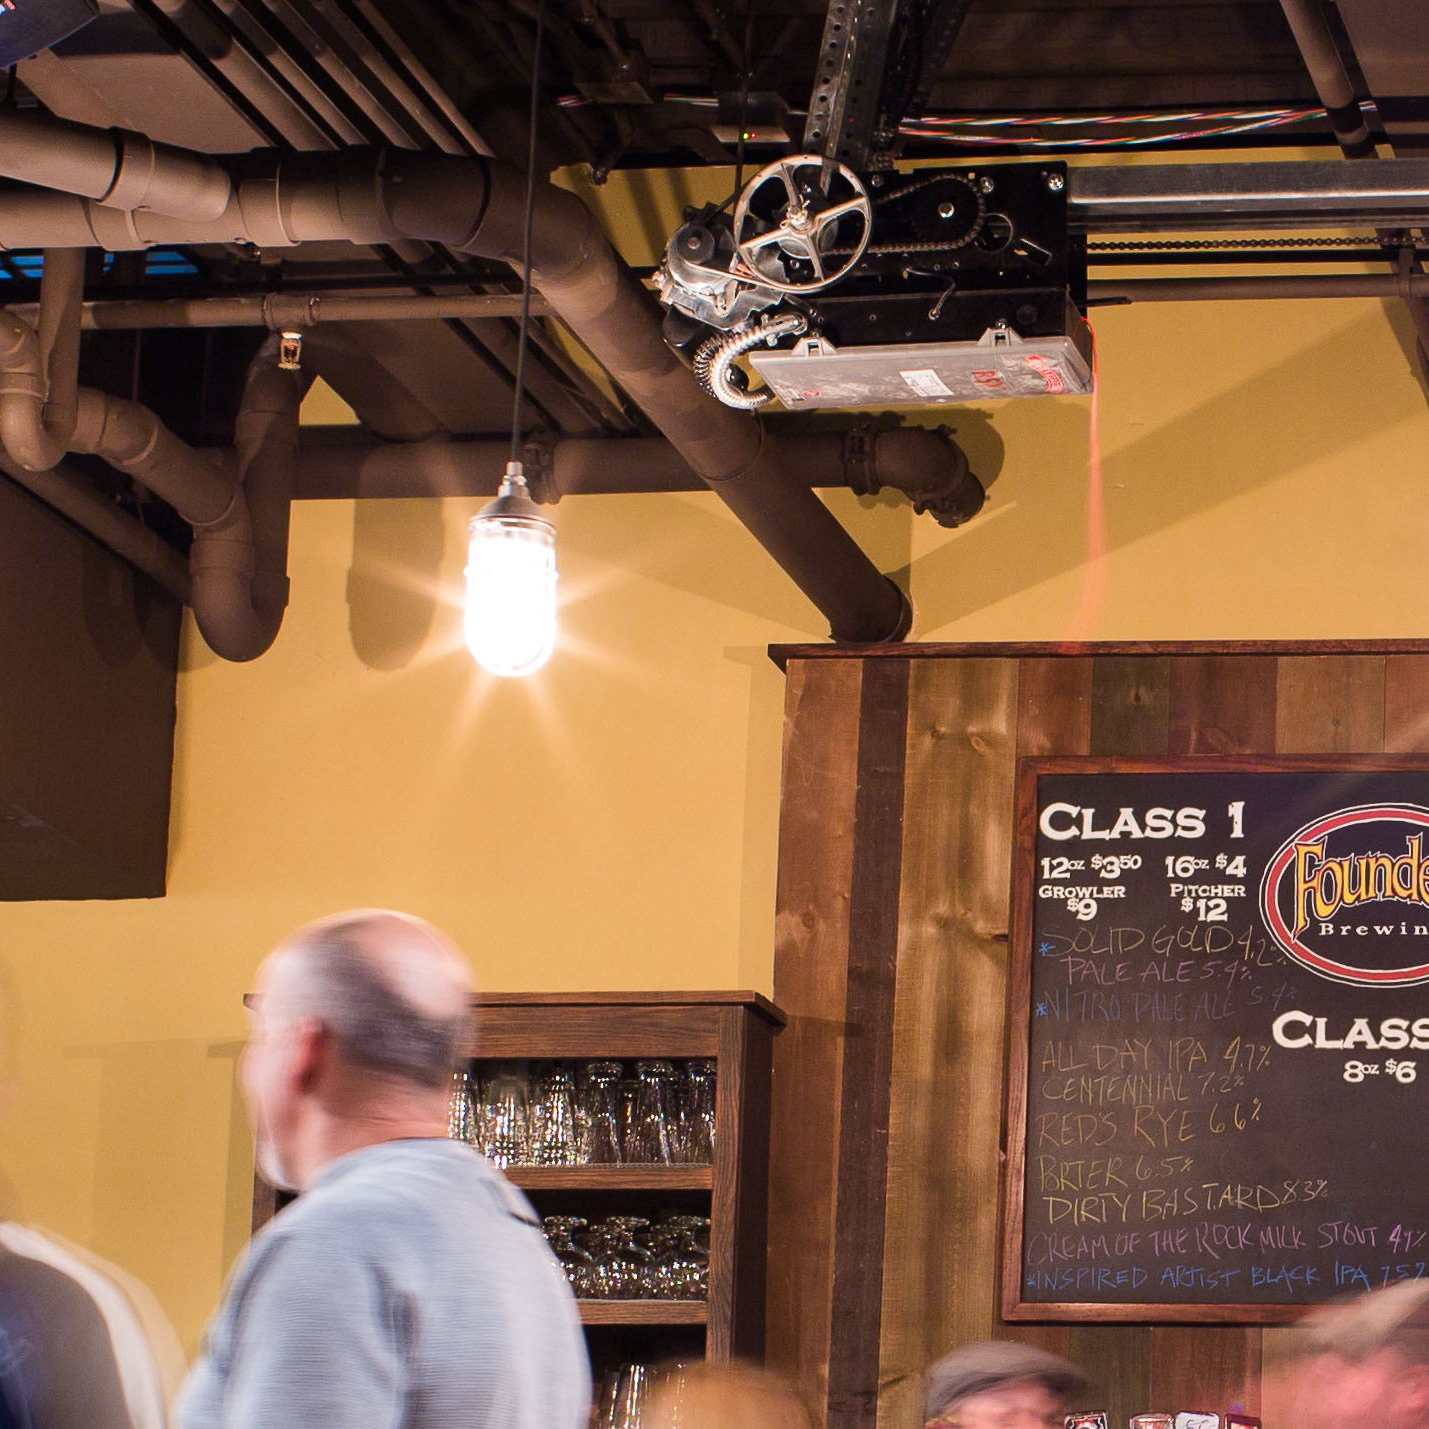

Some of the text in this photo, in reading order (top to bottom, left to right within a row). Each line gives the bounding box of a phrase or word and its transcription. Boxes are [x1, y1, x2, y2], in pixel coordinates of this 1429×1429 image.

[1039, 801, 1245, 841] CLASS 1
[1215, 853, 1247, 878] $4
[1038, 884, 1126, 898] GROWLER
[1170, 883, 1247, 897] PITCHER
[1067, 897, 1098, 921] $9
[1181, 896, 1228, 922] $12
[1060, 955, 1133, 985] PALE
[1139, 960, 1195, 982] ALE
[1041, 1039, 1087, 1072] ALL
[1093, 1038, 1152, 1072] DAY
[1169, 1037, 1208, 1072] IPA
[1385, 1058, 1417, 1084] $6
[1042, 1073, 1188, 1105] CENTENNIAL
[1134, 1105, 1195, 1148] RYE
[1043, 1192, 1131, 1227] DIRTY
[1027, 1232, 1111, 1265] CREAM
[1115, 1232, 1140, 1256] OF
[1149, 1228, 1188, 1257] THE
[1259, 1223, 1307, 1255] MILK
[1318, 1220, 1378, 1249] STOUT
[1252, 1264, 1320, 1294] BLACK
[1334, 1260, 1372, 1292] IPA
